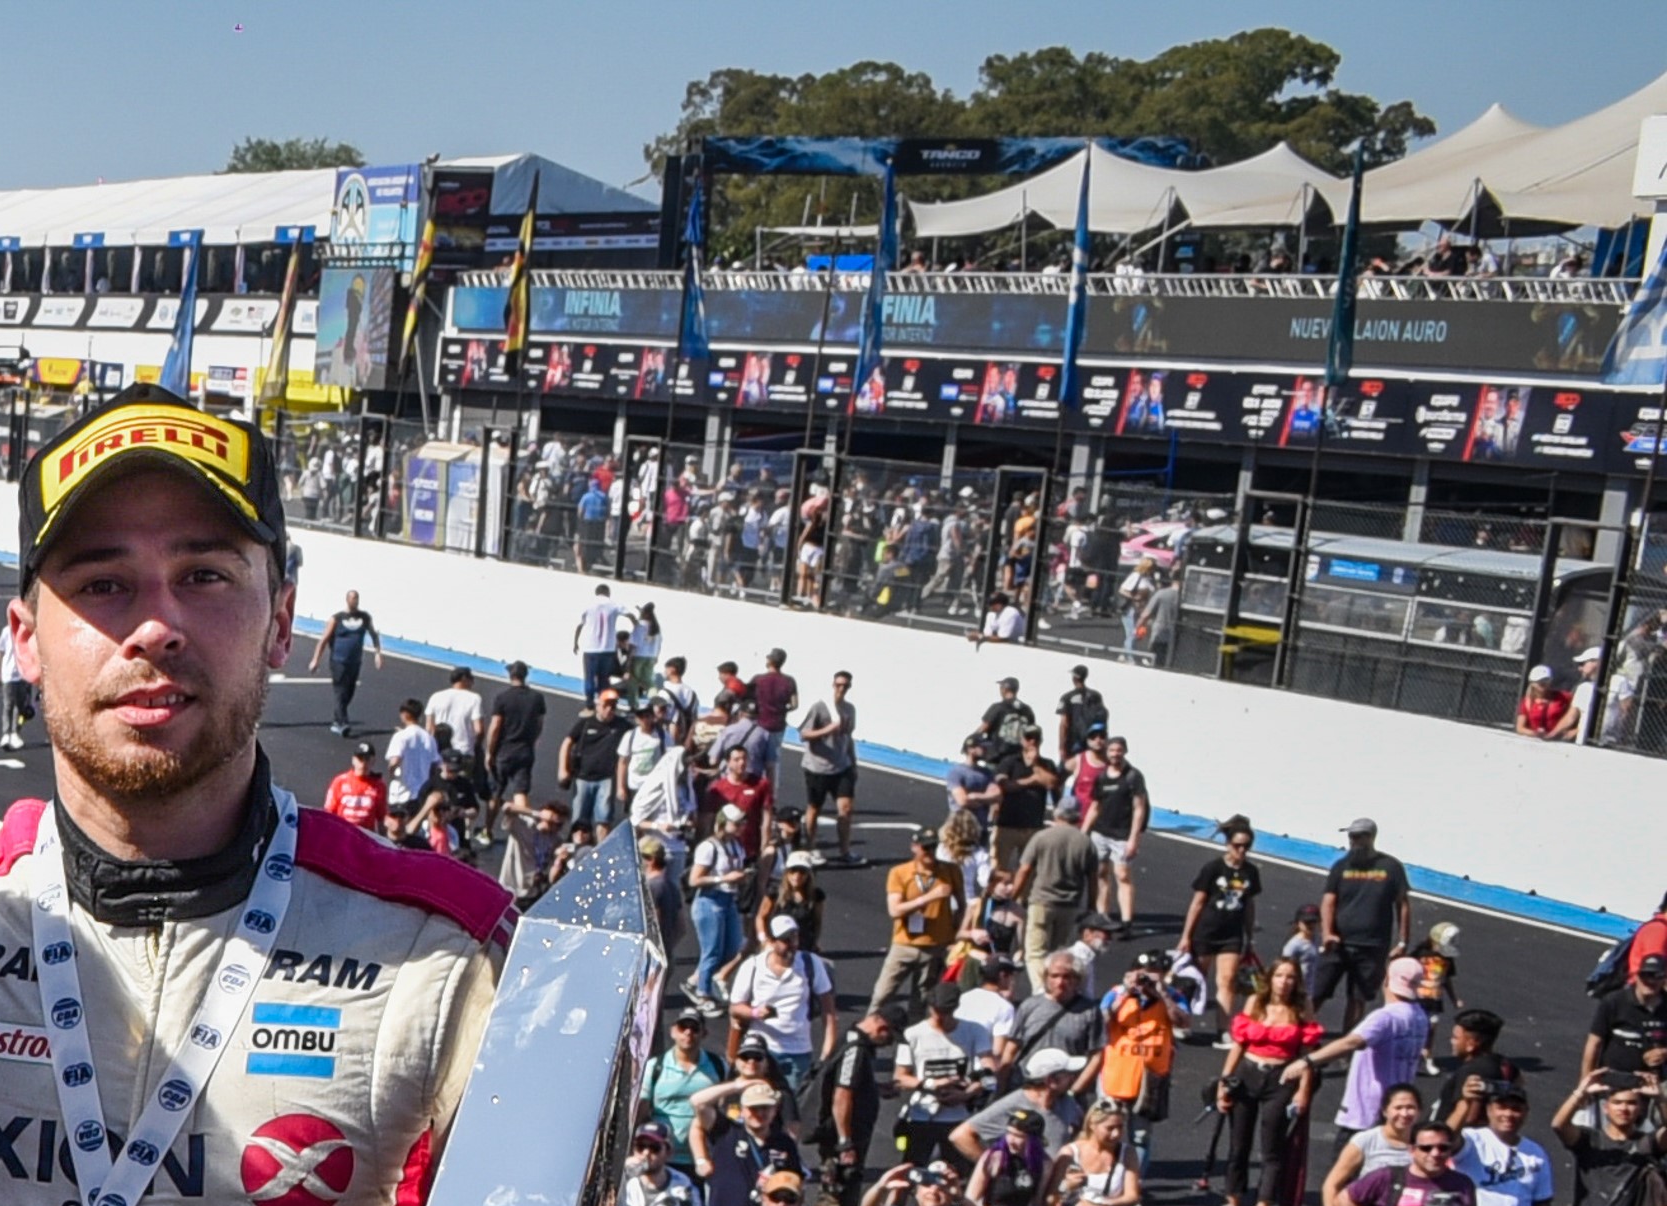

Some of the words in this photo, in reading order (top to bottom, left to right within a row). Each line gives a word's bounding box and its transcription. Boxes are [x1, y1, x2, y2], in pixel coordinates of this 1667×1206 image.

[881, 295, 939, 325] FINIA
[1290, 317, 1332, 338] NUEV
[1352, 319, 1400, 341] LAION
[59, 416, 229, 484] PIRELLI
[246, 911, 271, 931] FIA
[44, 943, 71, 961] FIA
[264, 949, 382, 991] RAM
[193, 1026, 217, 1046] FIA
[252, 1028, 335, 1052] OMBU
[64, 1065, 91, 1084] FIA
[129, 1142, 155, 1161] FIA
